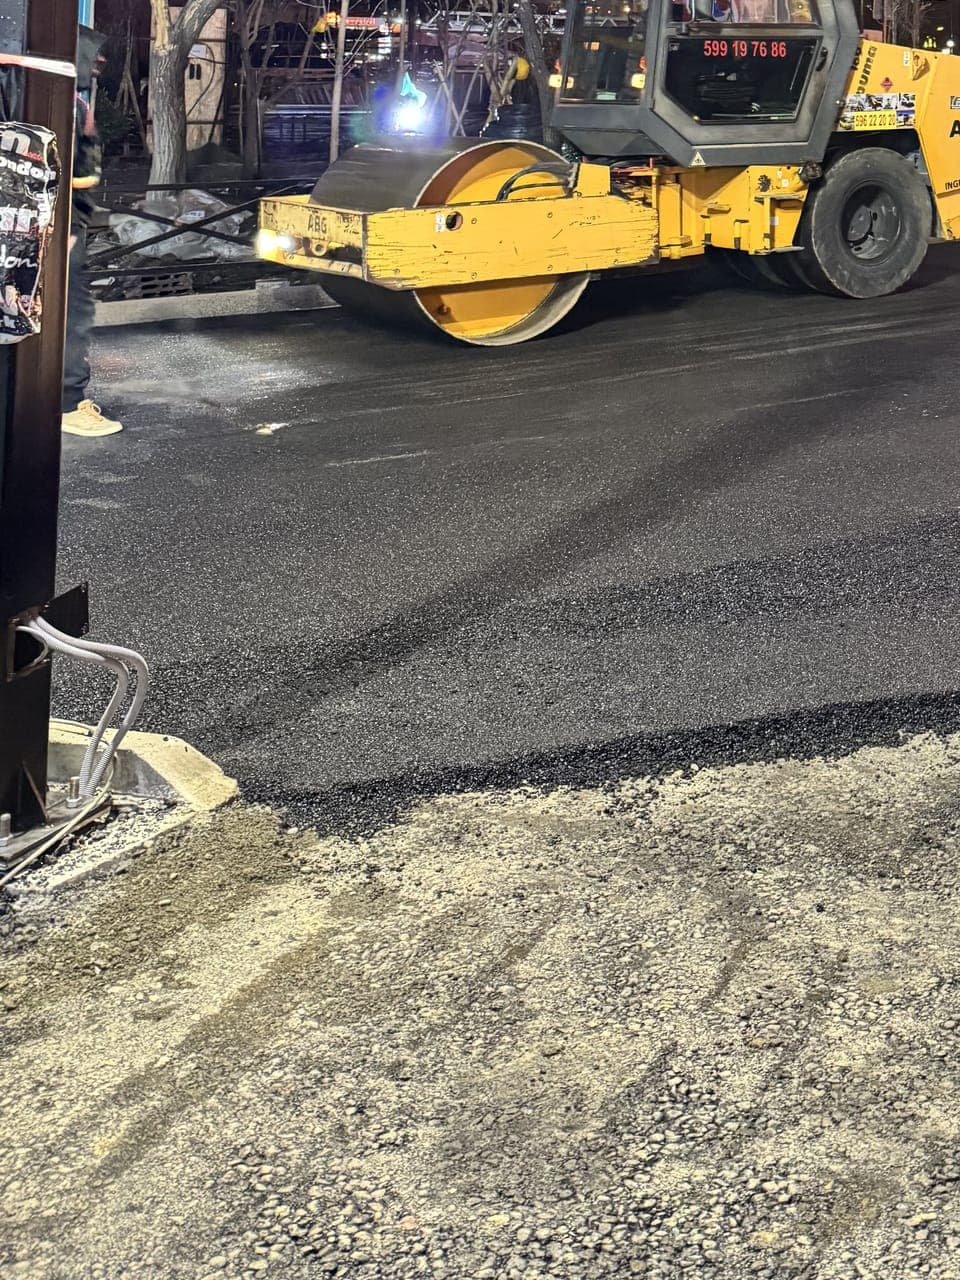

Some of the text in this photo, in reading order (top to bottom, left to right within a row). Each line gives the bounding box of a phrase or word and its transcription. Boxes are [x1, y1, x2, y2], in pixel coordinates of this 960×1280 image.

[704, 40, 786, 58] 599 19 76 86
[307, 214, 328, 234] ABG
